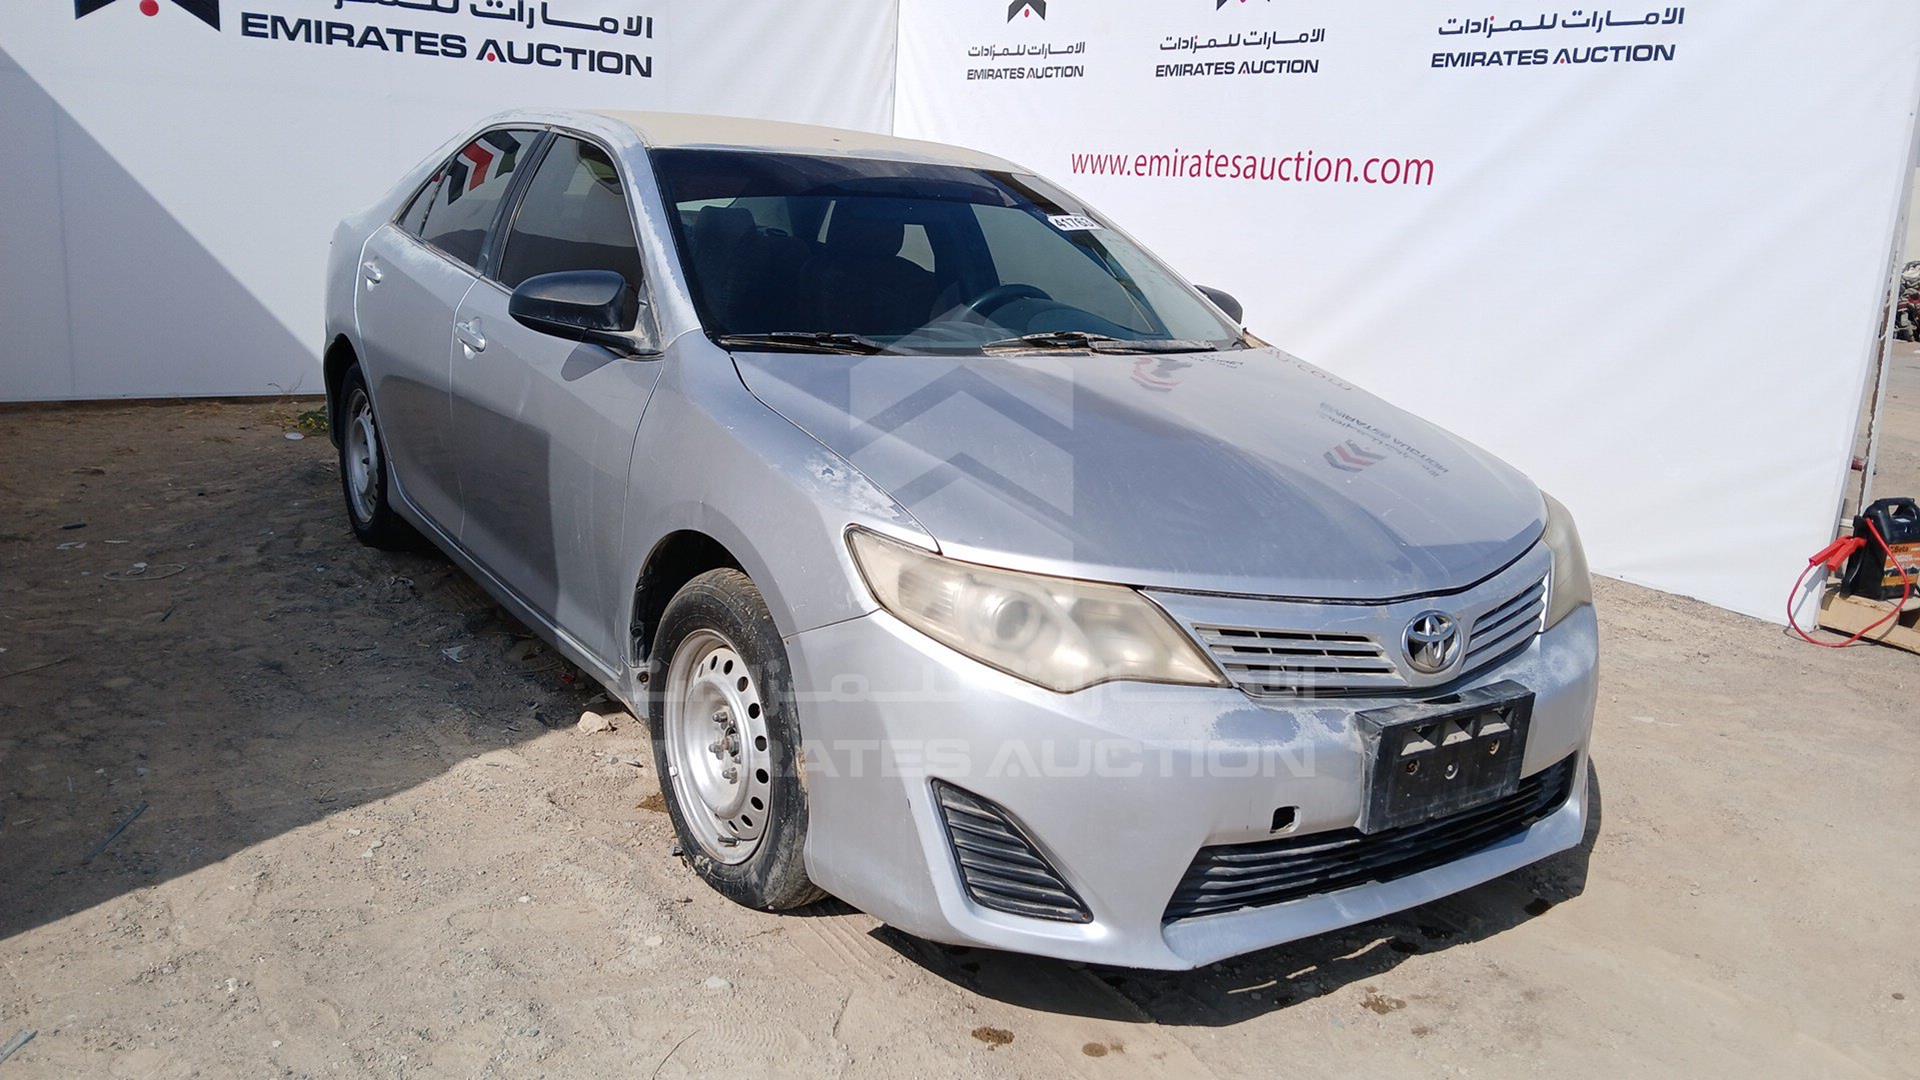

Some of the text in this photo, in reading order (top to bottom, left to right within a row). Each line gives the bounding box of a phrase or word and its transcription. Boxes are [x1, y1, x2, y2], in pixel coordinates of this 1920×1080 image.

[240, 11, 653, 79] EMIRATES AUCTION
[1430, 43, 1677, 69] EMIRATES AUCTION
[966, 64, 1085, 81] EMIRATES AUCTION
[1155, 58, 1320, 78] EMIRATES AUCTION
[1071, 147, 1435, 186] www.emiratesauction.com
